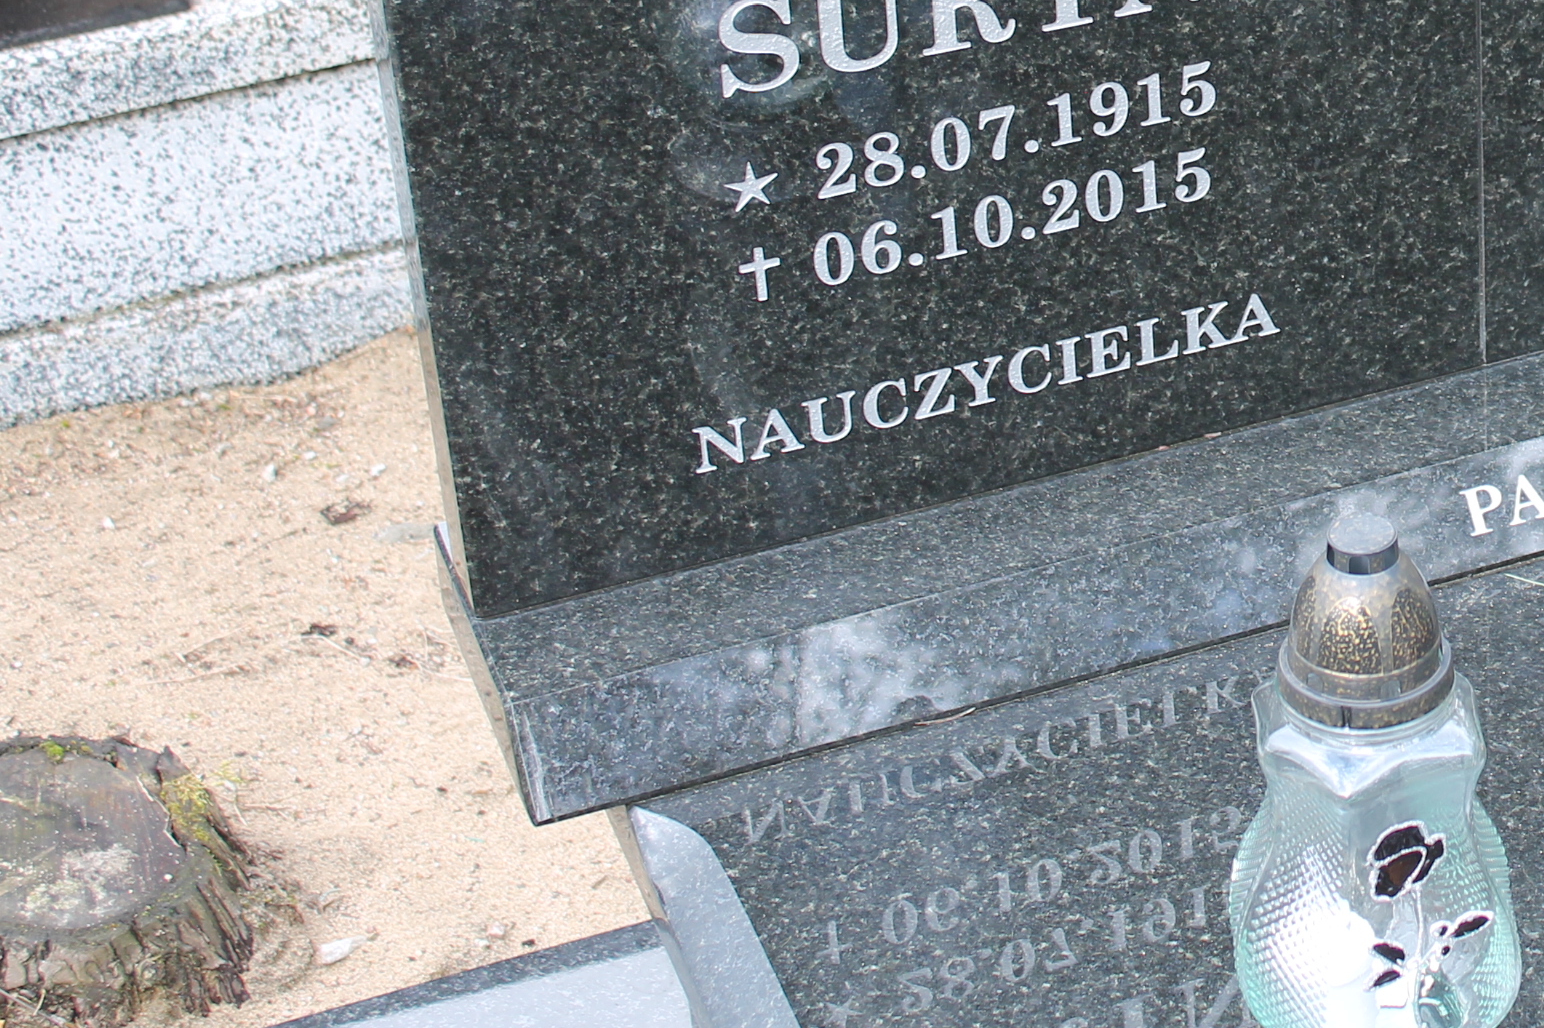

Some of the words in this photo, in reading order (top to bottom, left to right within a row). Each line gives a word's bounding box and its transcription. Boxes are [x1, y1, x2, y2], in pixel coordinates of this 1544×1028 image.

[815, 60, 1218, 201] 28.07.1915
[812, 147, 1213, 287] 06.10.2015
[691, 292, 1282, 475] NAUCZYCIELKA
